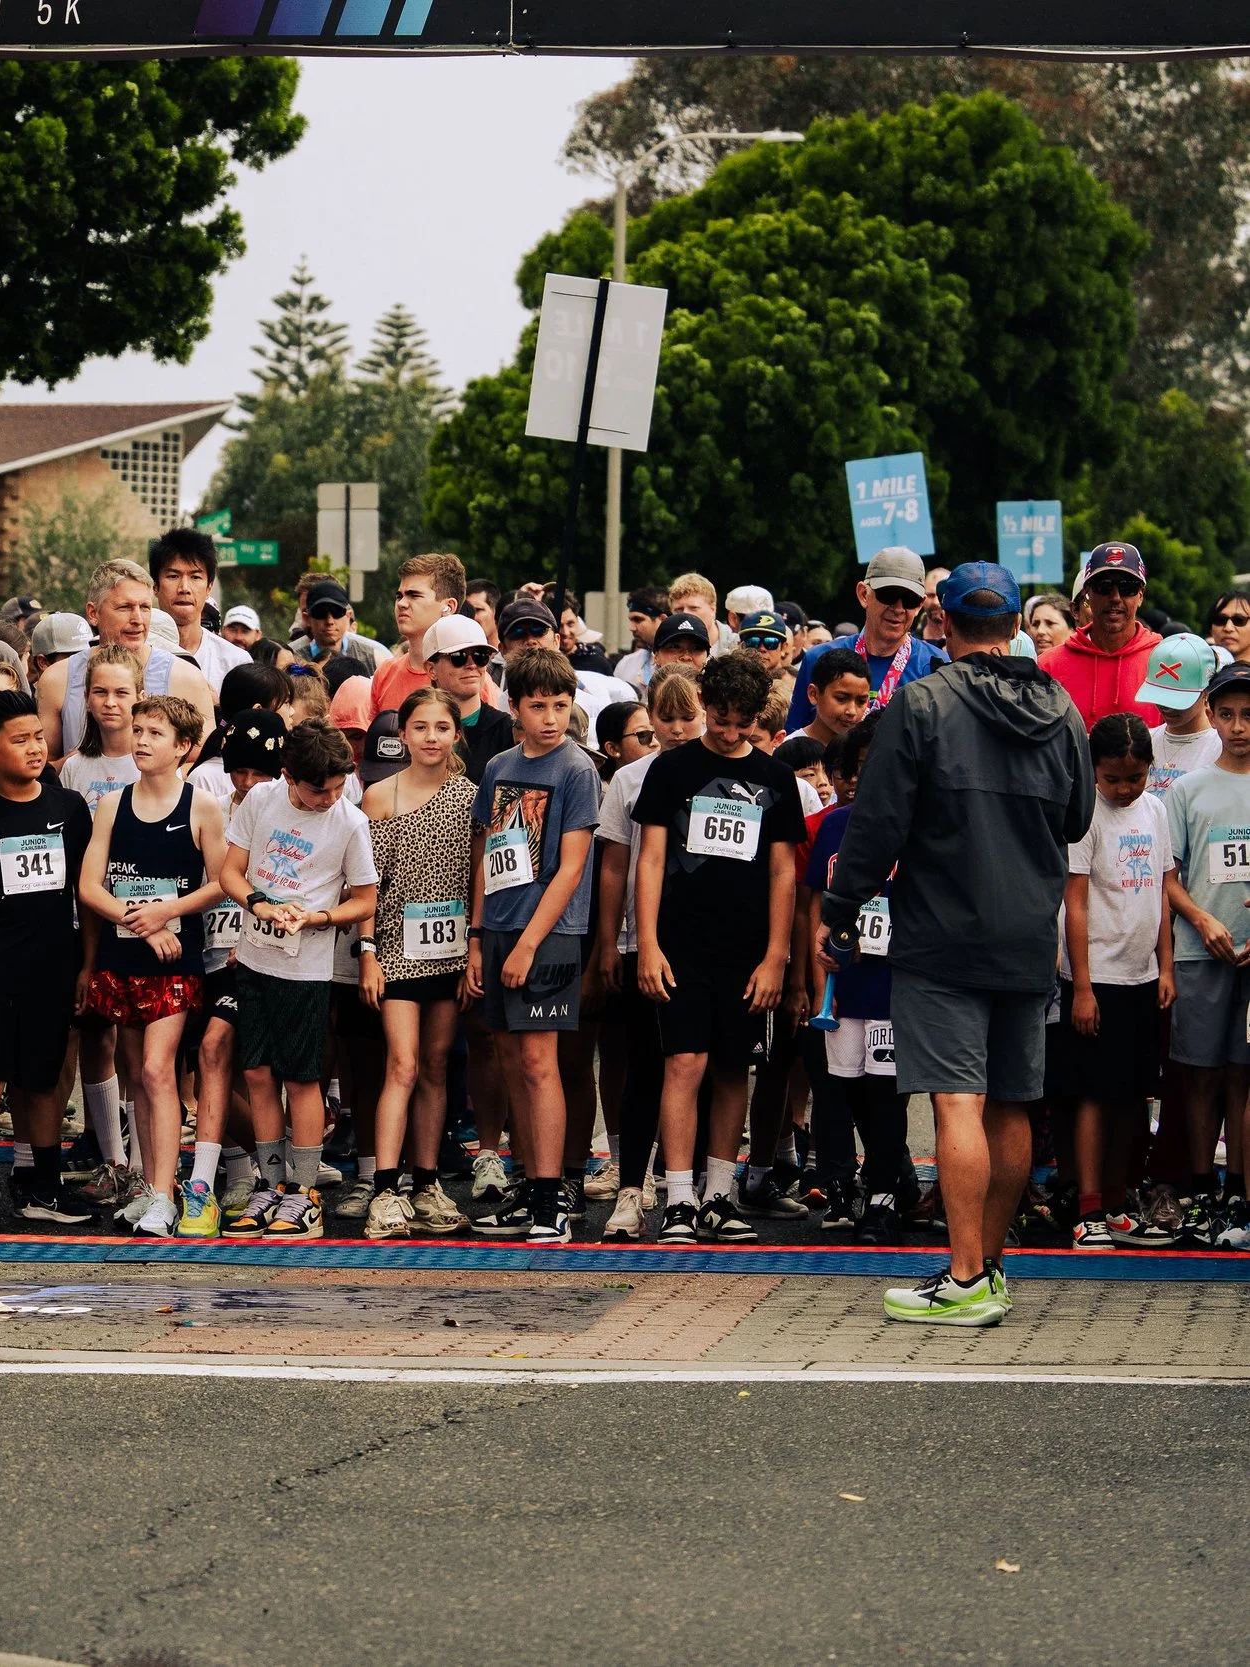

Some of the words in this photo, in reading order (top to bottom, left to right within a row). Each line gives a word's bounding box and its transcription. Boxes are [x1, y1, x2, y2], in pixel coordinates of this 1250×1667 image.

[37, 0, 81, 25] 5K
[856, 480, 867, 500] 1
[872, 474, 917, 498] MILE
[882, 498, 919, 526] 7-8
[1021, 515, 1056, 533] MILE
[1032, 536, 1046, 557] 6
[713, 809, 742, 818] CARLSBAD
[714, 802, 743, 812] JUNIOR
[270, 828, 314, 855] JUNIOR
[704, 816, 746, 844] 656
[20, 838, 47, 847] JUNIOR
[15, 852, 55, 878] 341
[490, 848, 517, 878] 208
[1223, 843, 1250, 867] 51
[109, 861, 139, 875] PEAK.
[130, 884, 156, 892] JUNIOR
[424, 905, 450, 913] JUNIOR
[207, 911, 242, 936] 274
[419, 919, 456, 944] 183
[530, 1004, 569, 1018] MAN
